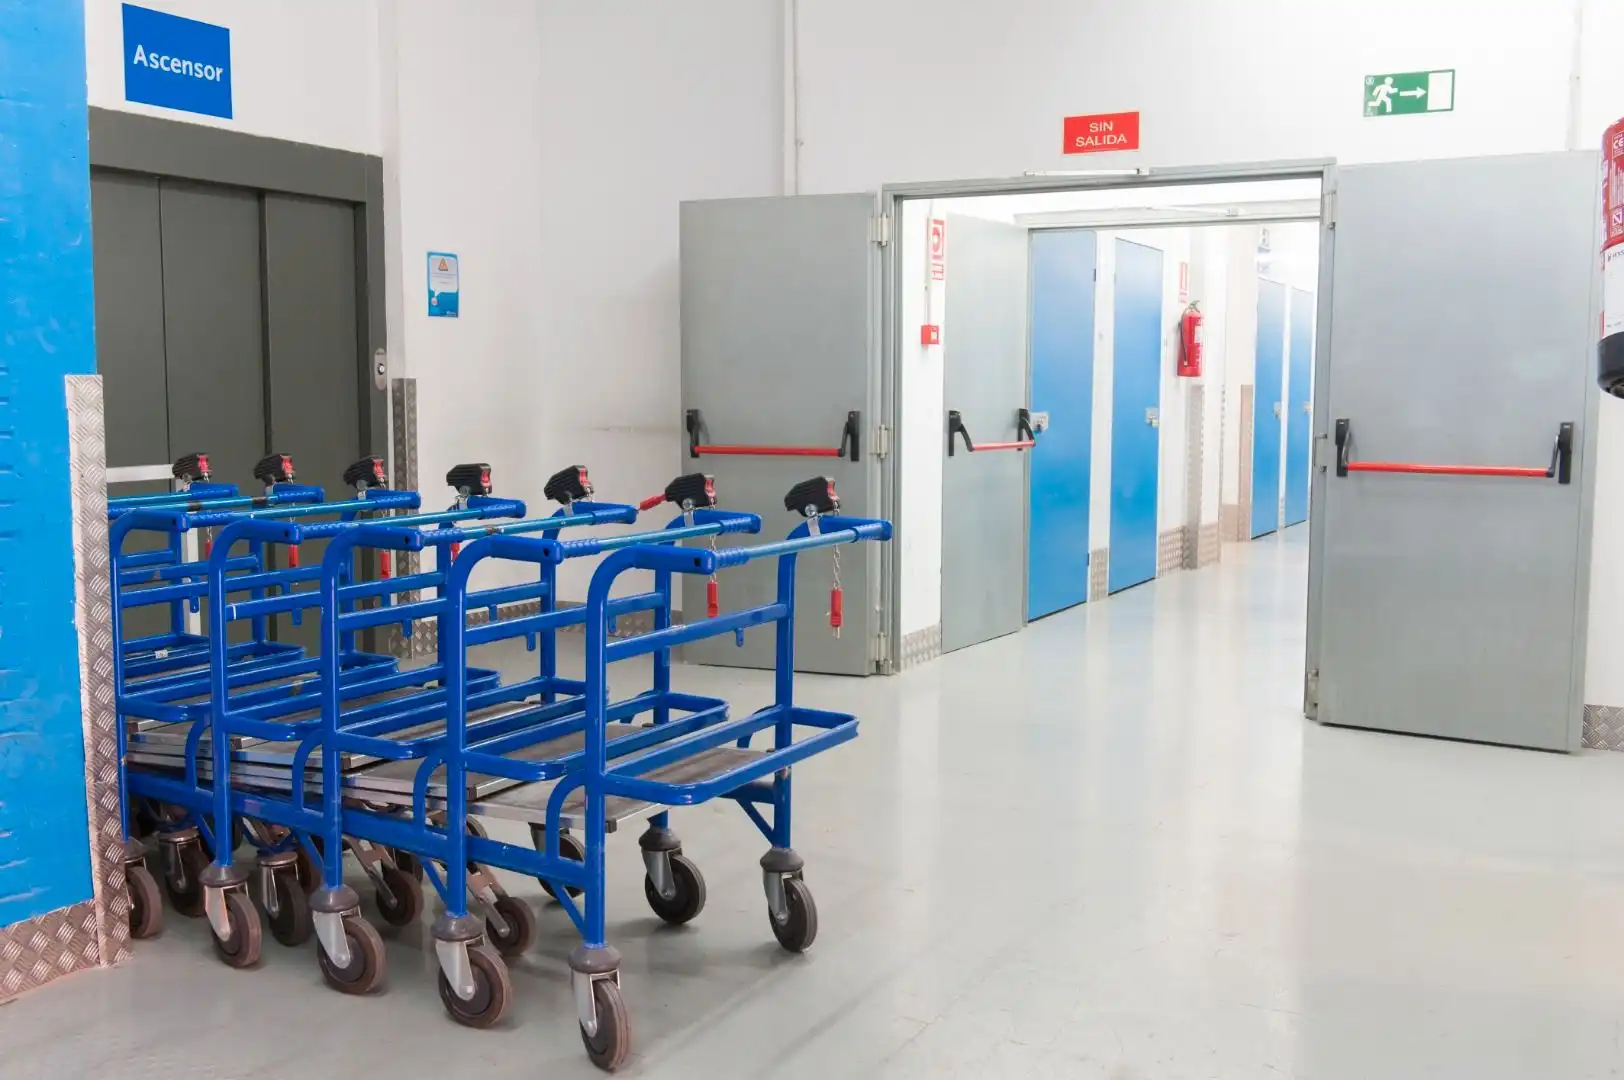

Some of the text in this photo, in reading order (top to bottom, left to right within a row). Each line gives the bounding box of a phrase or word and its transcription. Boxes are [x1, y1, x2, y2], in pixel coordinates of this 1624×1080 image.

[133, 44, 223, 82] Ascensor
[1089, 121, 1113, 133] SIN
[1075, 133, 1128, 147] SALIDA
